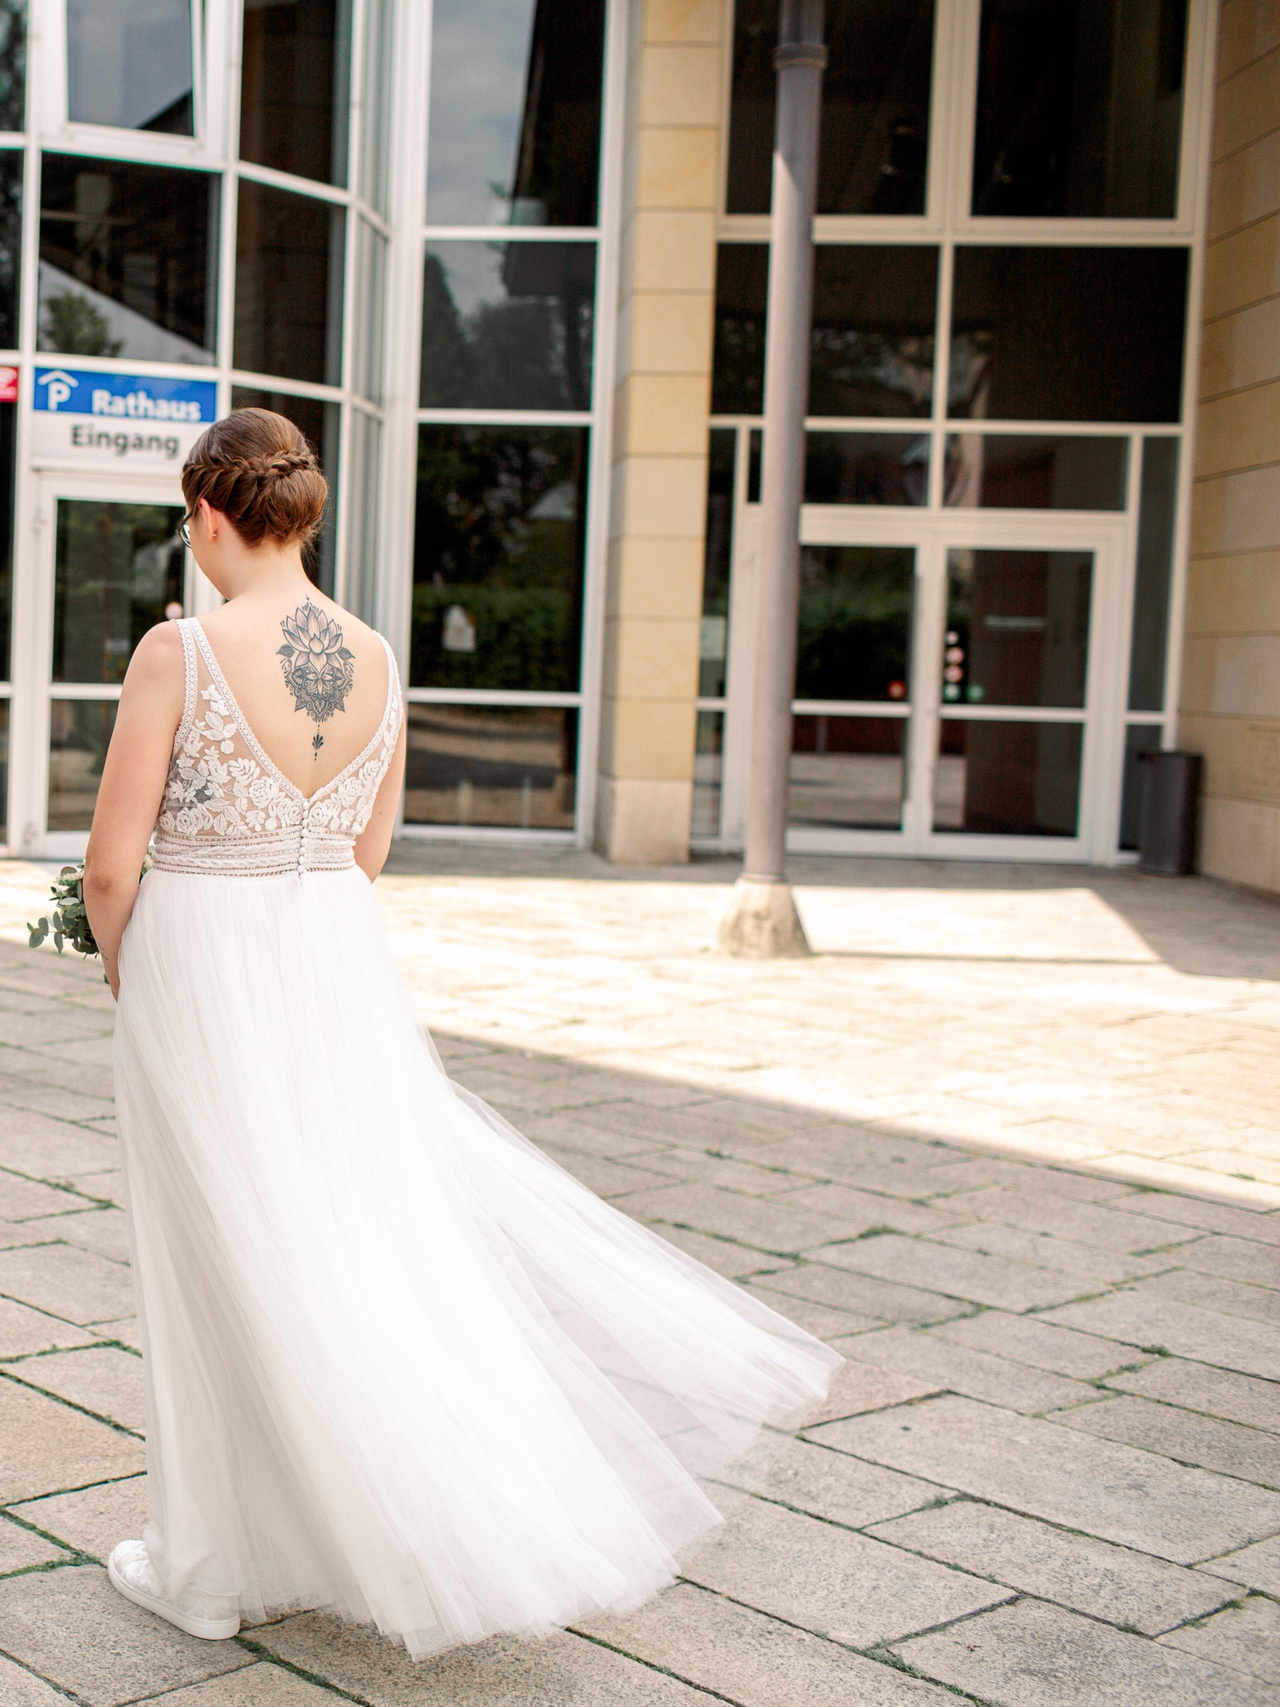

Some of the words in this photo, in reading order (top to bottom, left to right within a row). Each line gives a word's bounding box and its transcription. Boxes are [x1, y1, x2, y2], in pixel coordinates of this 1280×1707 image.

[49, 382, 72, 411] P
[91, 389, 202, 422] Rathaus
[72, 424, 180, 457] Eingang
